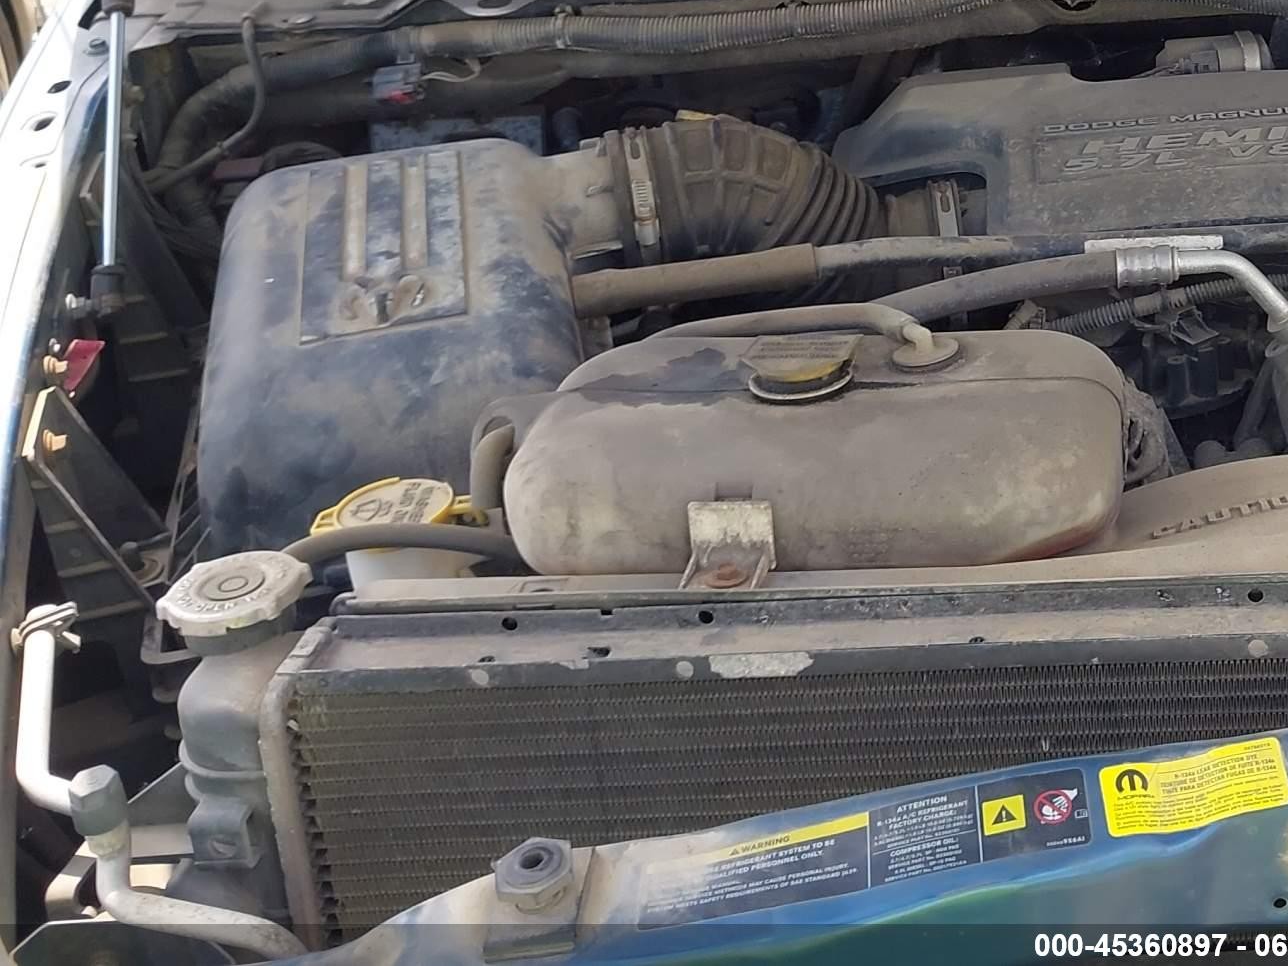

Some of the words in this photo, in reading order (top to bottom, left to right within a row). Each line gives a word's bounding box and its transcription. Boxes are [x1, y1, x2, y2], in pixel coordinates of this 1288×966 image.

[1043, 117, 1158, 134] DODGE
[896, 795, 948, 813] ATTENTION
[918, 800, 968, 816] REFRIGERANT
[889, 816, 922, 830] FACTORY
[741, 834, 791, 854] WARNING
[812, 841, 823, 851] TO
[824, 838, 836, 848] BE
[890, 840, 942, 857] COMPRESSOR
[751, 856, 800, 872] PERSONNEL
